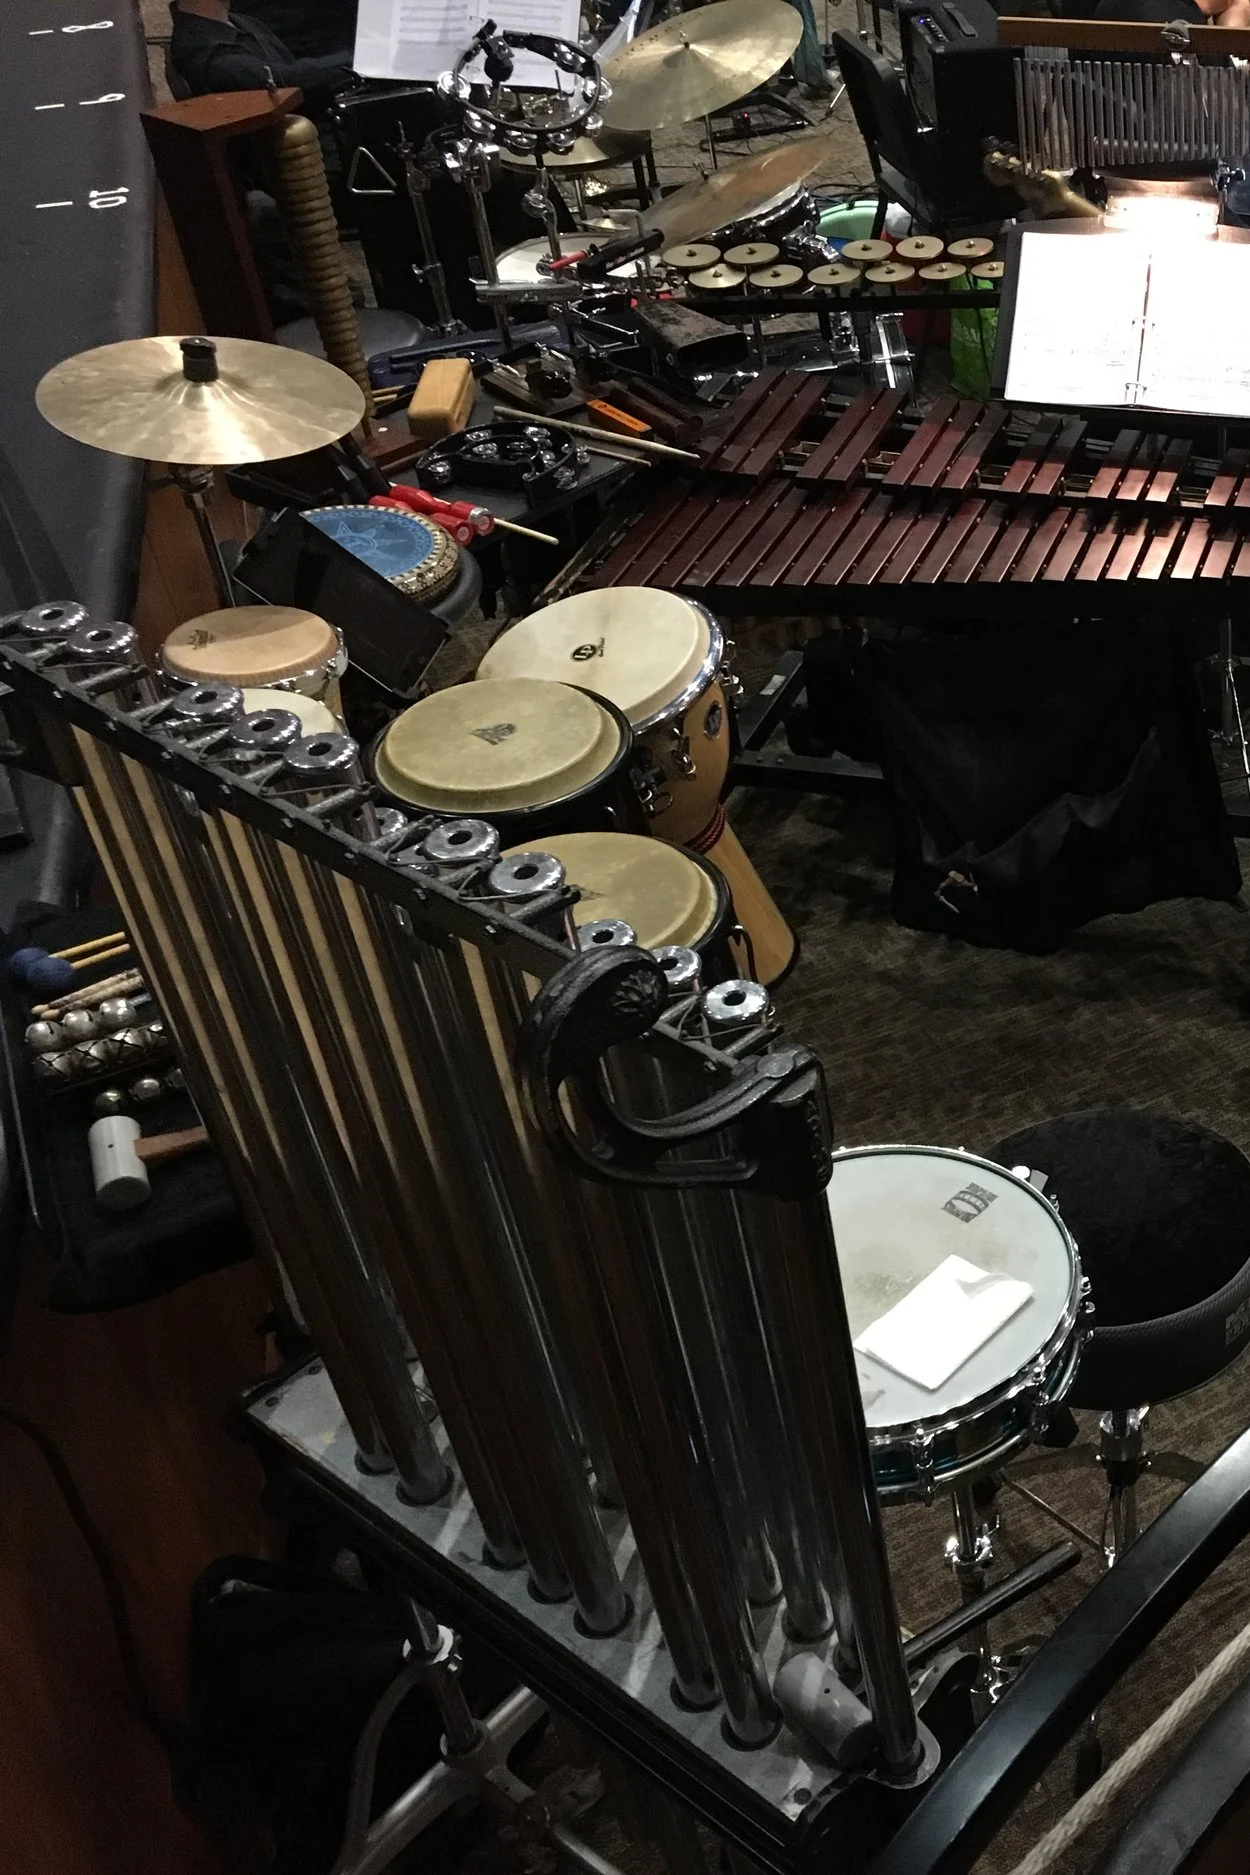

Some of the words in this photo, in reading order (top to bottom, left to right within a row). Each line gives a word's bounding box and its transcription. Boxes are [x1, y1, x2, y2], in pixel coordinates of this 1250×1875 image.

[62, 20, 114, 33] 8
[79, 93, 126, 105] 9
[89, 187, 130, 210] 10
[573, 645, 594, 660] LP
